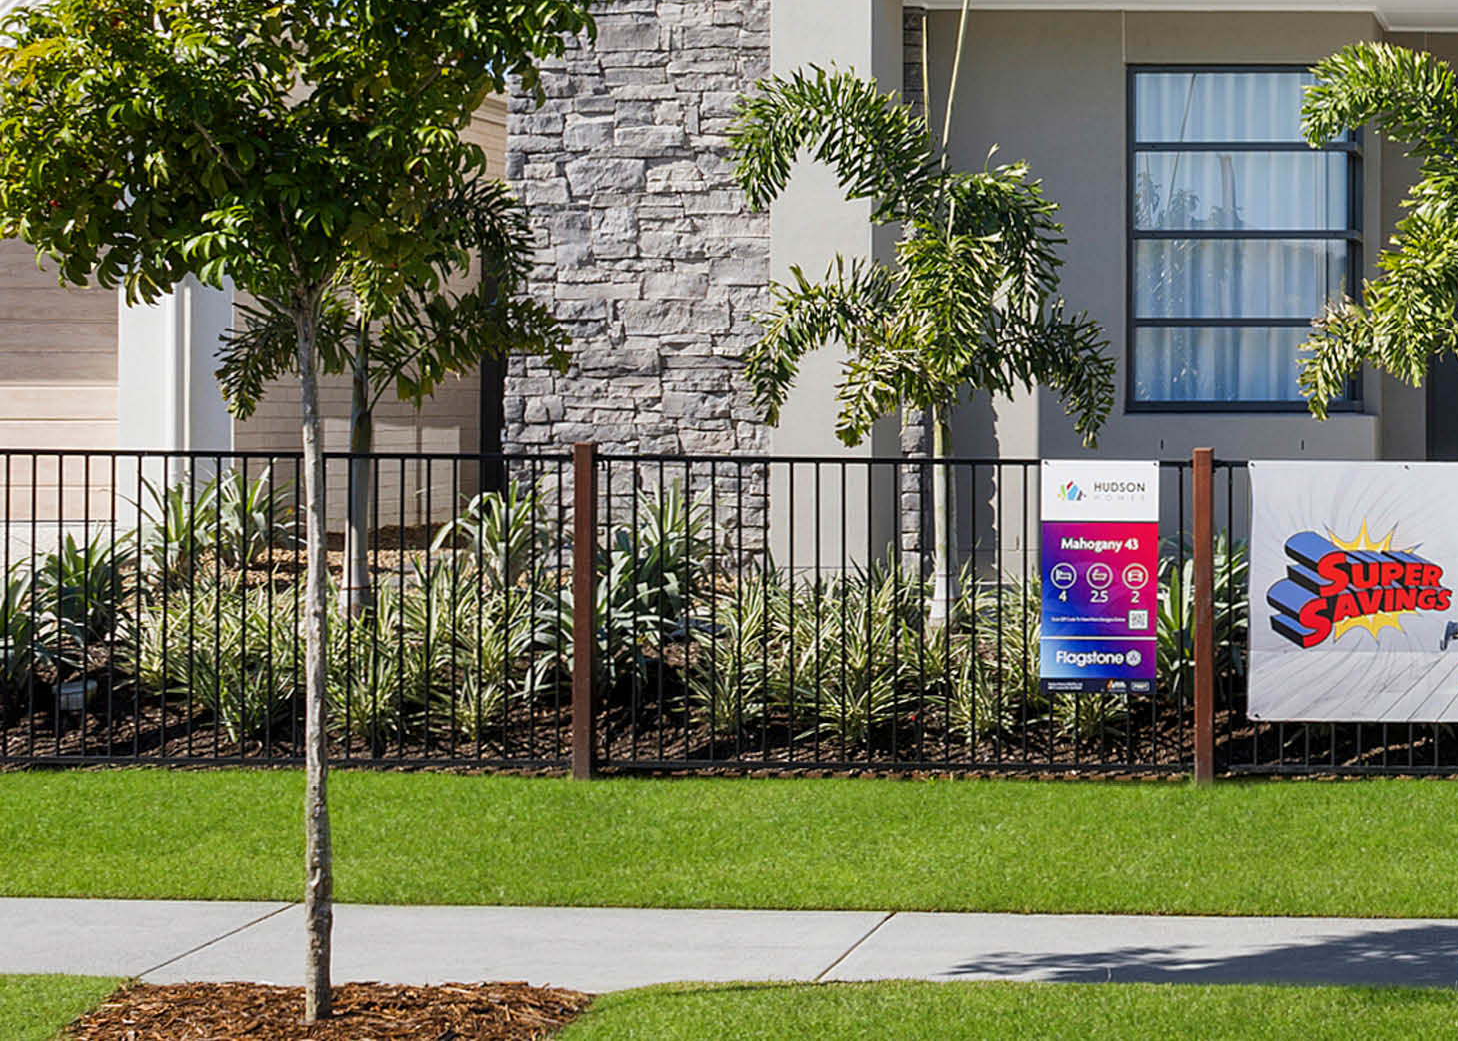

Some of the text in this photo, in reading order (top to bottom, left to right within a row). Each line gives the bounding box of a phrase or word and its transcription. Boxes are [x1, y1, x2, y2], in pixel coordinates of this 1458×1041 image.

[1094, 482, 1145, 493] HUDSON
[1061, 537, 1139, 553] Mahogany 43
[1317, 551, 1443, 598] SUPER
[1058, 590, 1068, 602] 4
[1130, 591, 1140, 603] 2
[1299, 588, 1452, 649] SAVINGS
[1055, 650, 1125, 667] Flagstone
